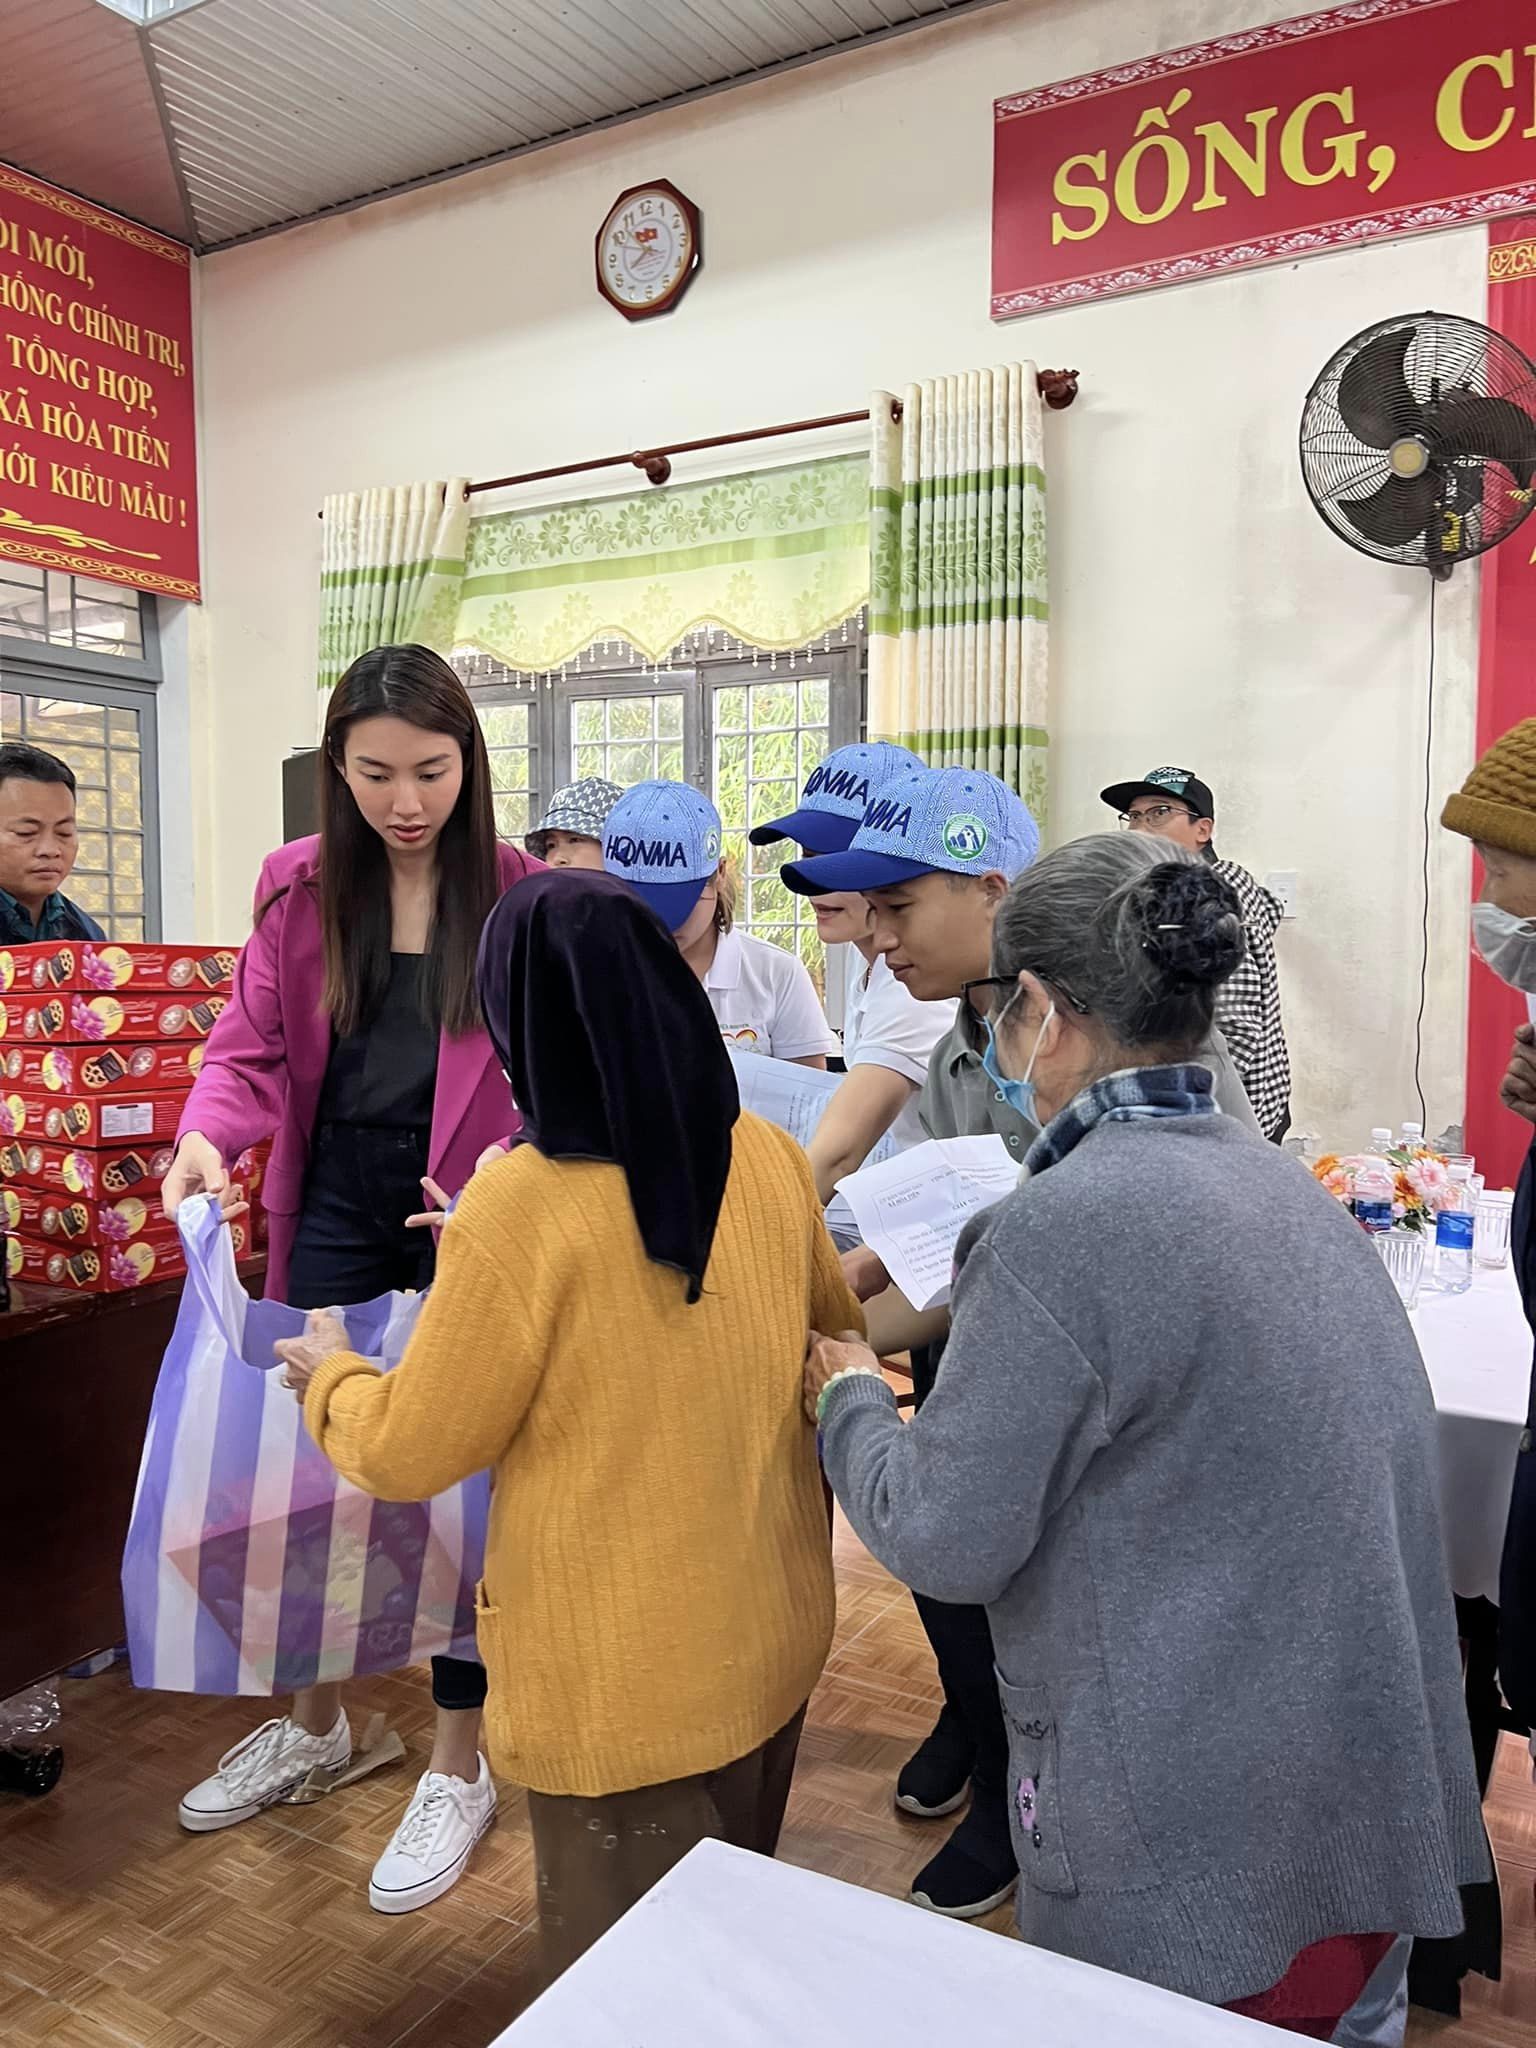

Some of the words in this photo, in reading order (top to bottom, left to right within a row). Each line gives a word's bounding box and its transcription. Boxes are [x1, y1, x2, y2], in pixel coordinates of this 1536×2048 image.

[1051, 86, 1396, 245] SỐNG,
[1435, 45, 1536, 152] C
[27, 228, 95, 291] MỚI,
[68, 301, 141, 355] CHÍNH
[144, 329, 186, 377] TRỊ,
[96, 365, 158, 419] HỢP,
[40, 401, 105, 450] HÒA
[605, 834, 688, 868] HONMA
